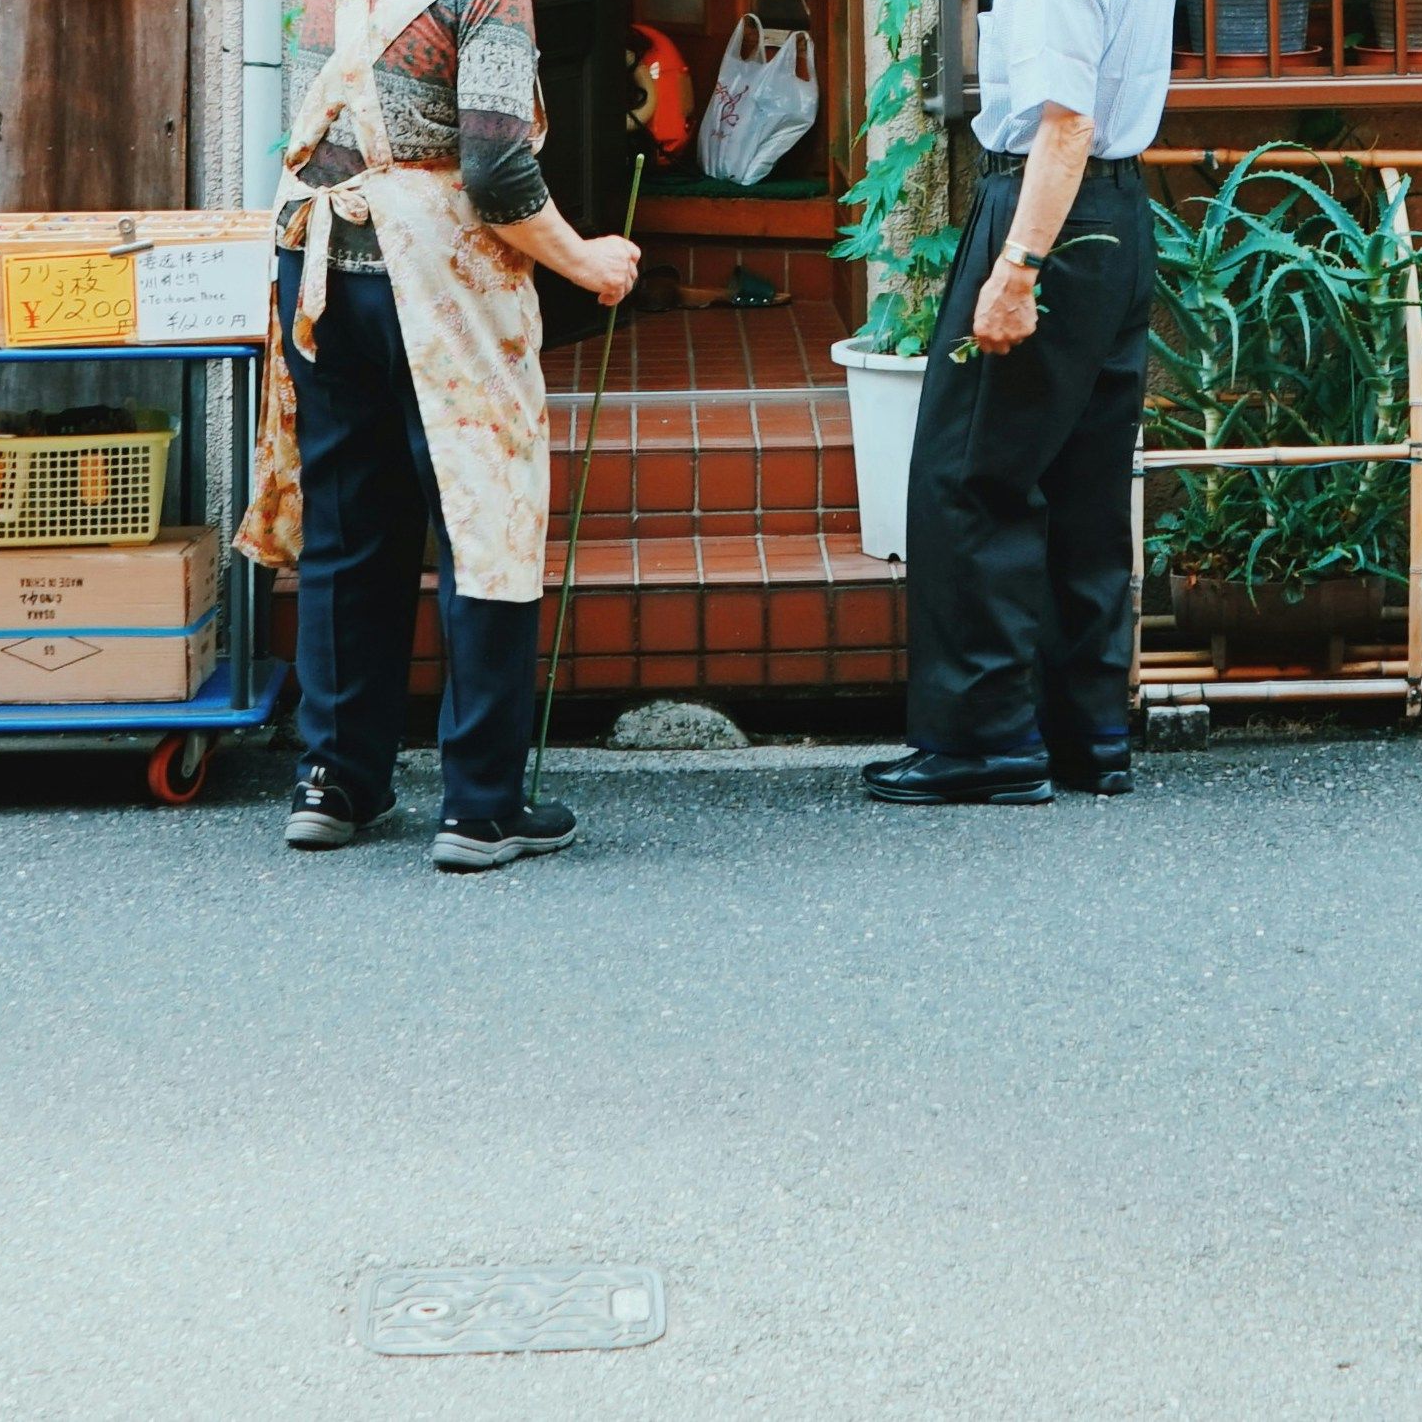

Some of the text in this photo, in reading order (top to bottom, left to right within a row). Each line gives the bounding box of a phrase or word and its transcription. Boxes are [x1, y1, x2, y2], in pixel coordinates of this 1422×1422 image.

[52, 275, 106, 296] 3枚
[20, 577, 83, 588] MADE IN CHINA
[27, 609, 56, 620] OSAKA
